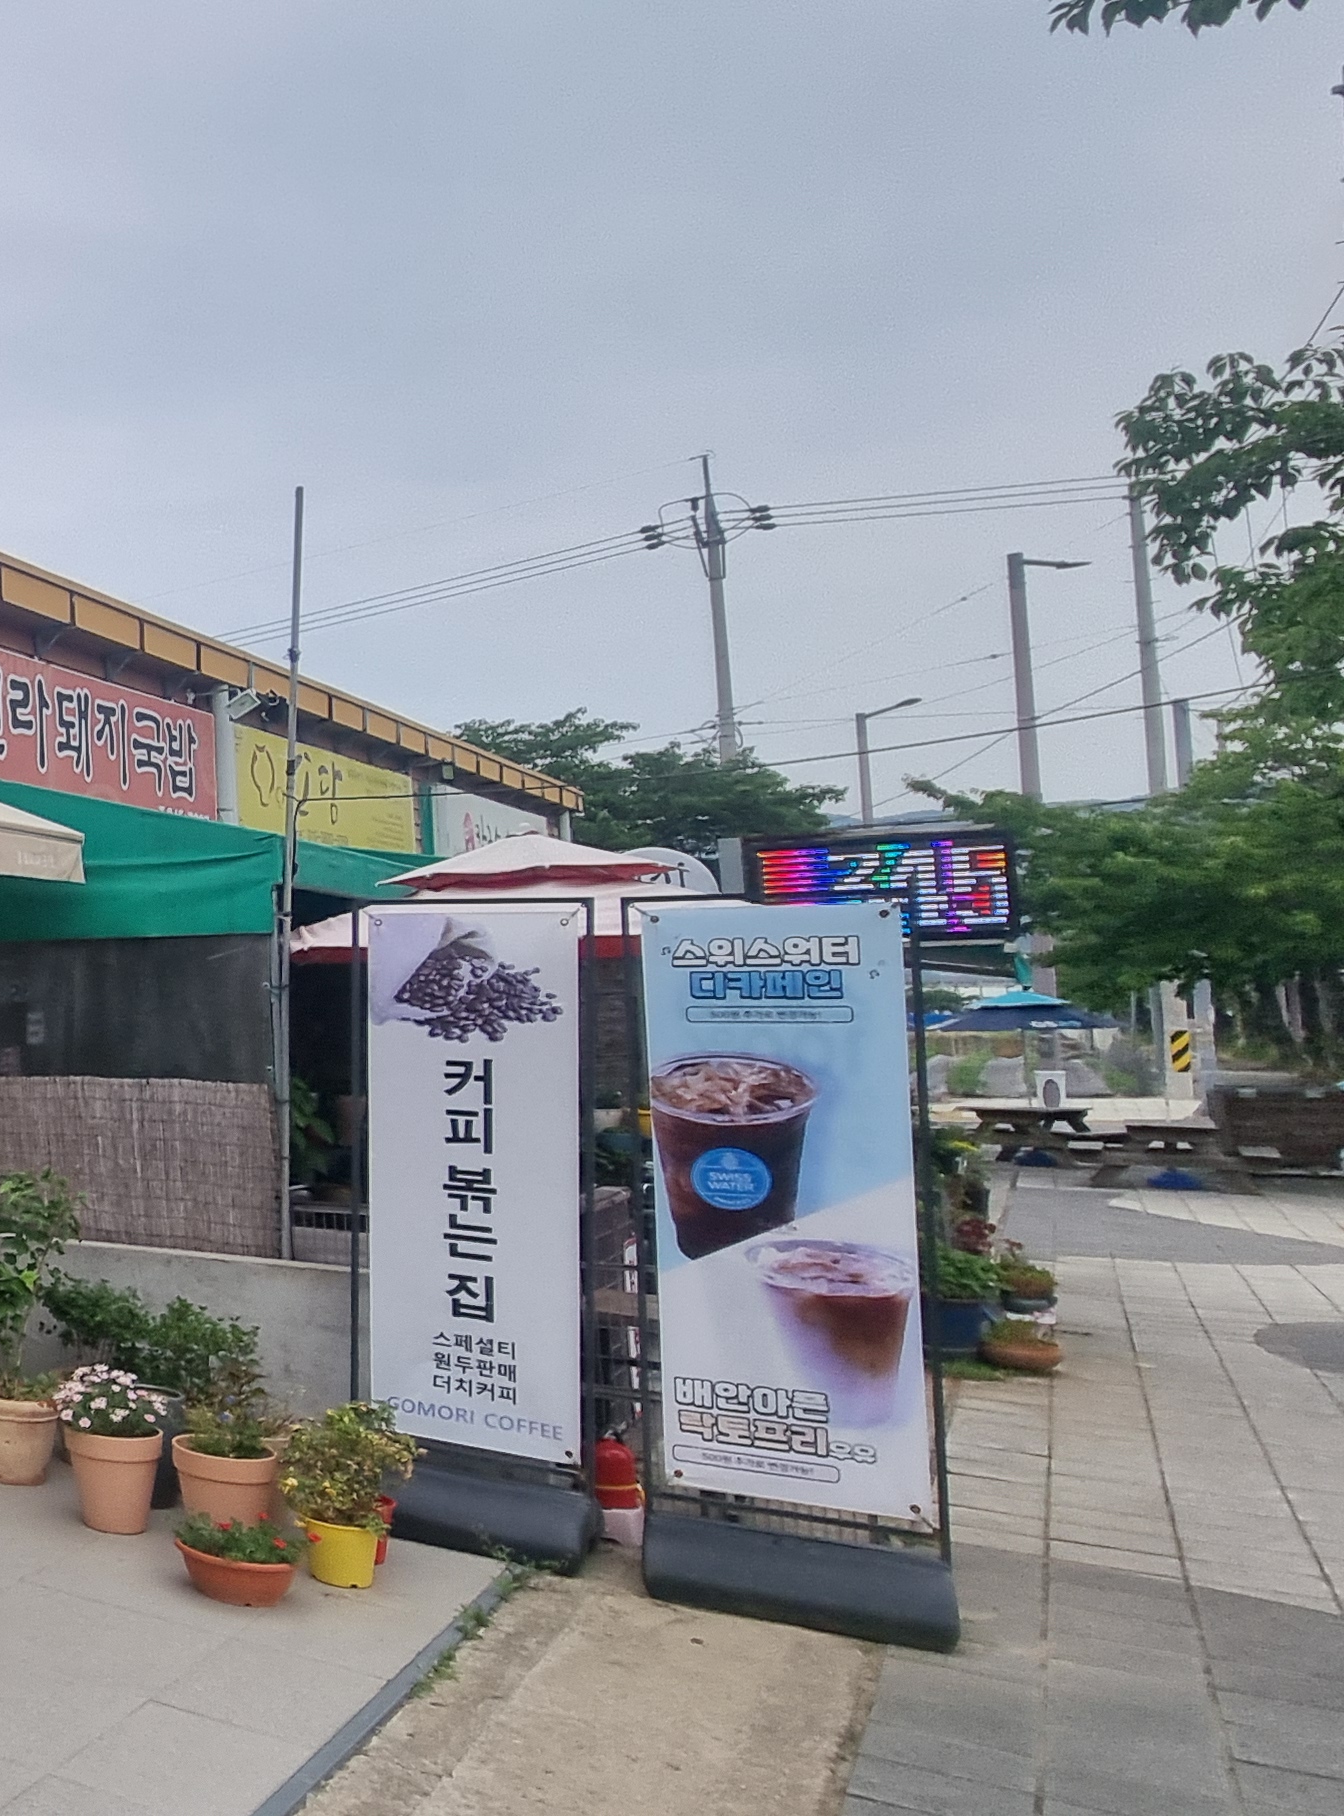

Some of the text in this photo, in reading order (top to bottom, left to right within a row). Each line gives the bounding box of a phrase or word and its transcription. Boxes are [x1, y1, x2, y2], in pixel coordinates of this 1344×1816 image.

[671, 935, 861, 967] 스위스워터
[689, 969, 844, 999] 디카페인
[442, 1058, 498, 1324] 커피 볶는 집
[432, 1331, 516, 1360] 스페셜티
[433, 1352, 517, 1383] 원두판매
[433, 1374, 517, 1405] 더치커피
[387, 1396, 564, 1441] GOMORI COFFEE
